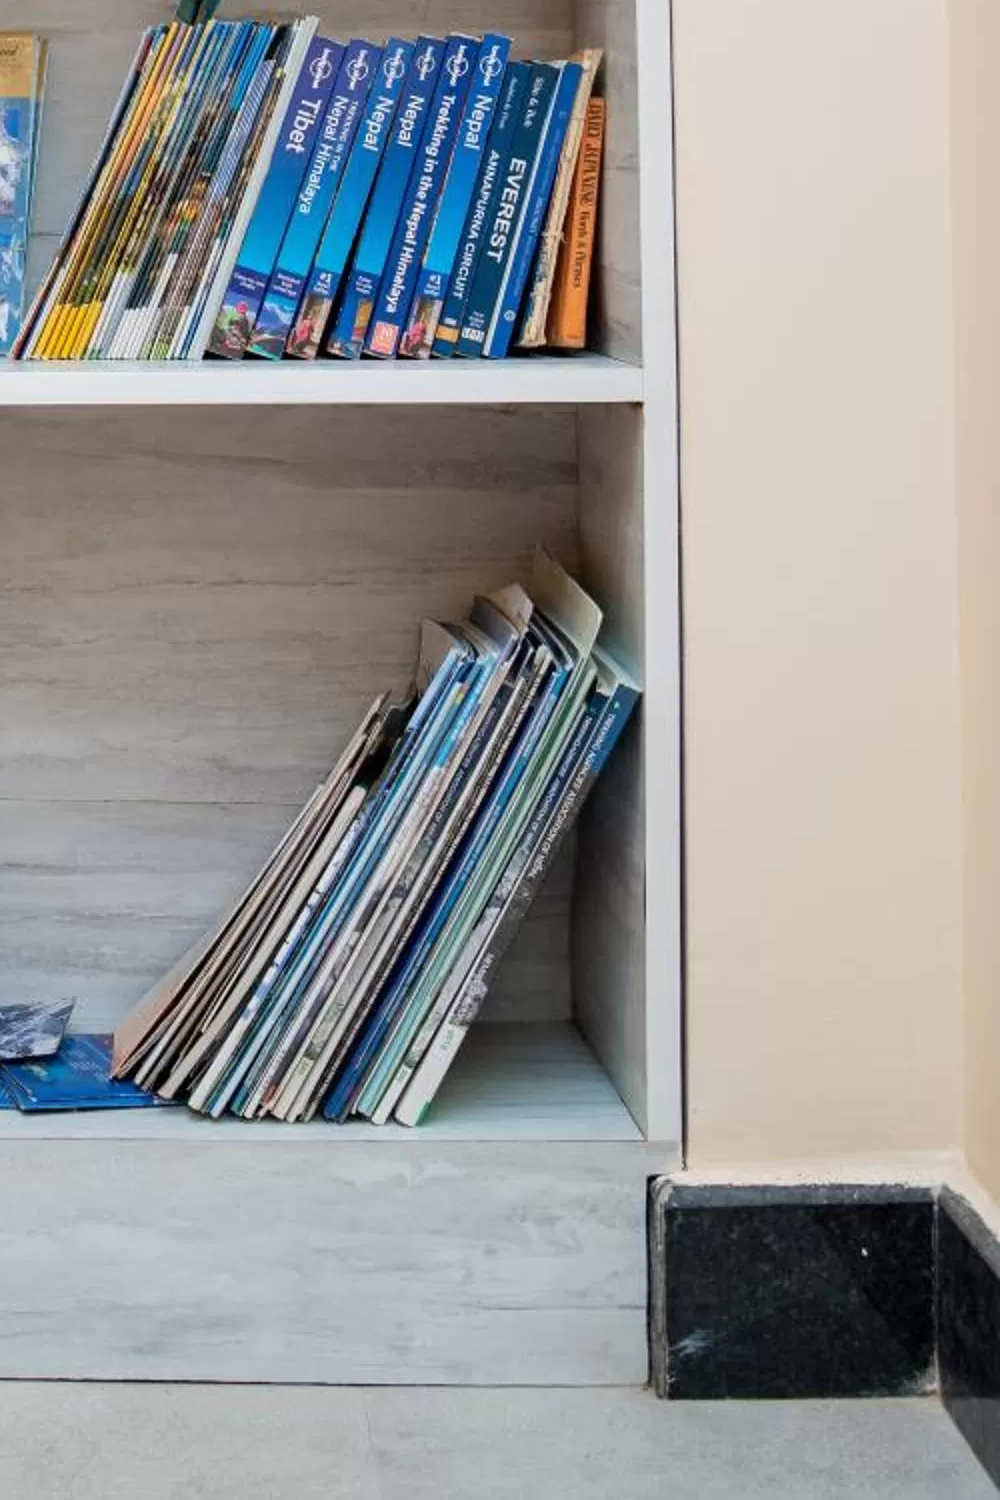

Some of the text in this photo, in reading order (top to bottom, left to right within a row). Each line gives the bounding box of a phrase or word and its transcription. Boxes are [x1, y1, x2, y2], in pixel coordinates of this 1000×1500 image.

[285, 99, 323, 154] Tibet
[299, 95, 349, 214] Nepal Himalaya
[363, 96, 393, 151] Nepal
[397, 95, 424, 147] Nepal
[463, 94, 492, 149] Nepal
[385, 94, 456, 314] Trekking in the Nepal Himalaya
[451, 149, 500, 300] ANNAPURNA CIRCUIT
[487, 157, 526, 262] EVEREST
